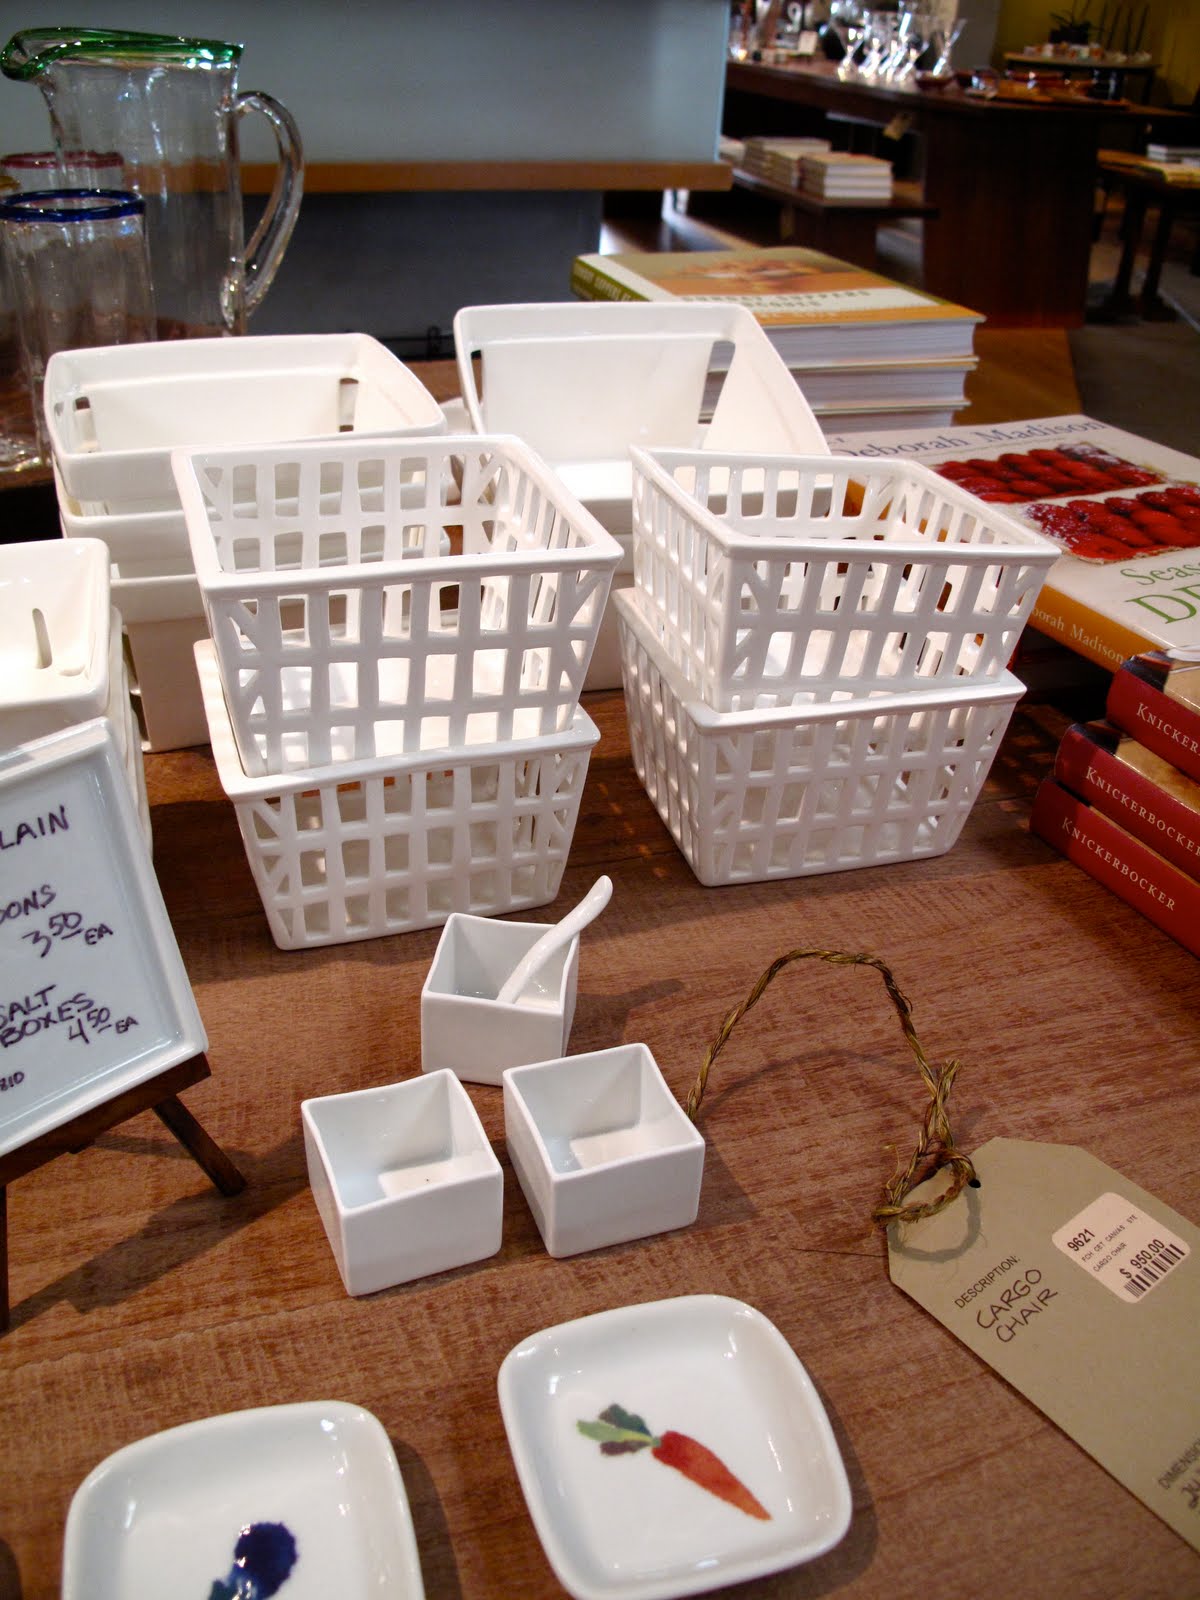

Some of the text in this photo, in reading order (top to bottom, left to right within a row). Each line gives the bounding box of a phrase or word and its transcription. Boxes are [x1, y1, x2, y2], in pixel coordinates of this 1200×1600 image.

[972, 421, 1106, 444] Madison
[1070, 624, 1124, 665] Madison
[1136, 702, 1200, 756] KNICKER
[1061, 817, 1176, 911] KNICKERBOCKER
[84, 923, 114, 946] EA
[0, 992, 94, 1048] BOXES
[115, 1016, 139, 1034] EA
[1067, 1228, 1095, 1252] 9621
[1110, 1242, 1128, 1257] CHAIR
[1130, 1238, 1165, 1270] 950.00
[954, 1255, 1021, 1309] DESCRIPTION:
[976, 1269, 1042, 1329] CARGO
[995, 1288, 1059, 1343] CHAIR
